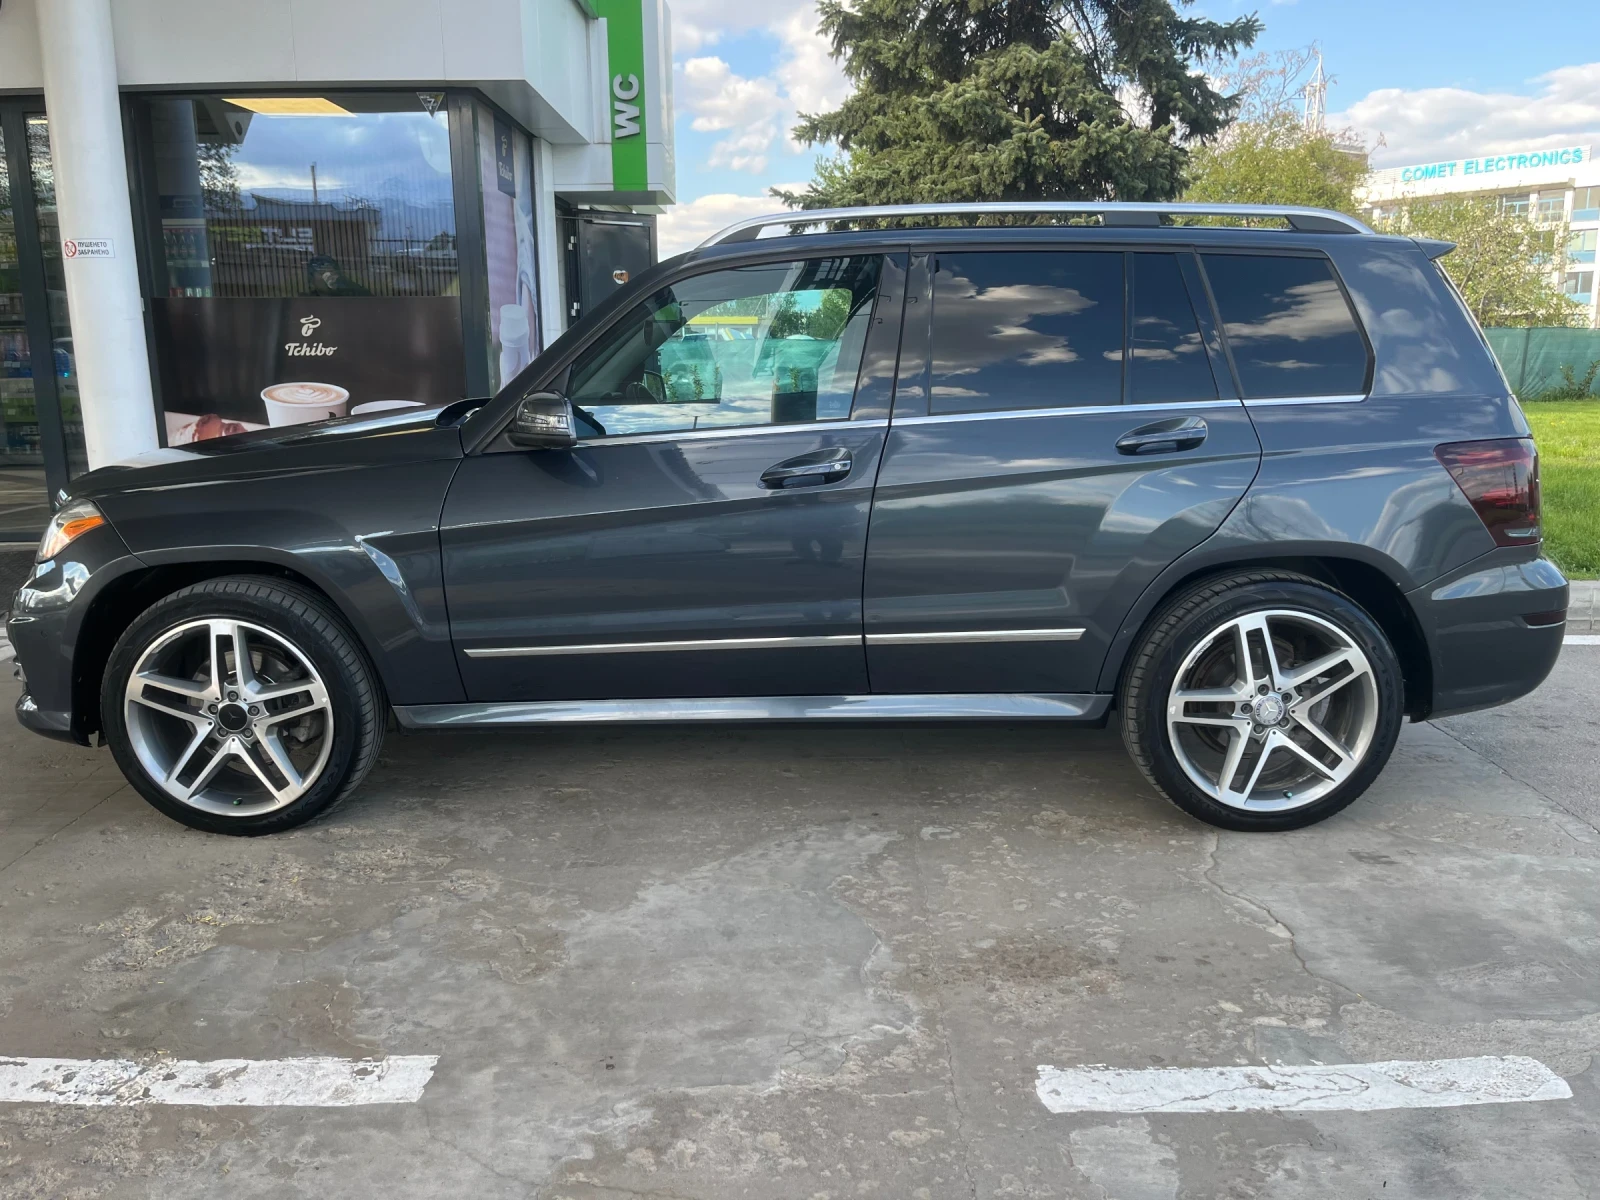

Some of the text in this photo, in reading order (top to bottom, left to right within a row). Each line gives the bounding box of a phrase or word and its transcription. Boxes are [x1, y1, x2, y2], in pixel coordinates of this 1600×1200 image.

[612, 73, 641, 139] WC
[1401, 147, 1583, 182] COMET ELECTRONICS
[284, 342, 338, 357] Tchibo
